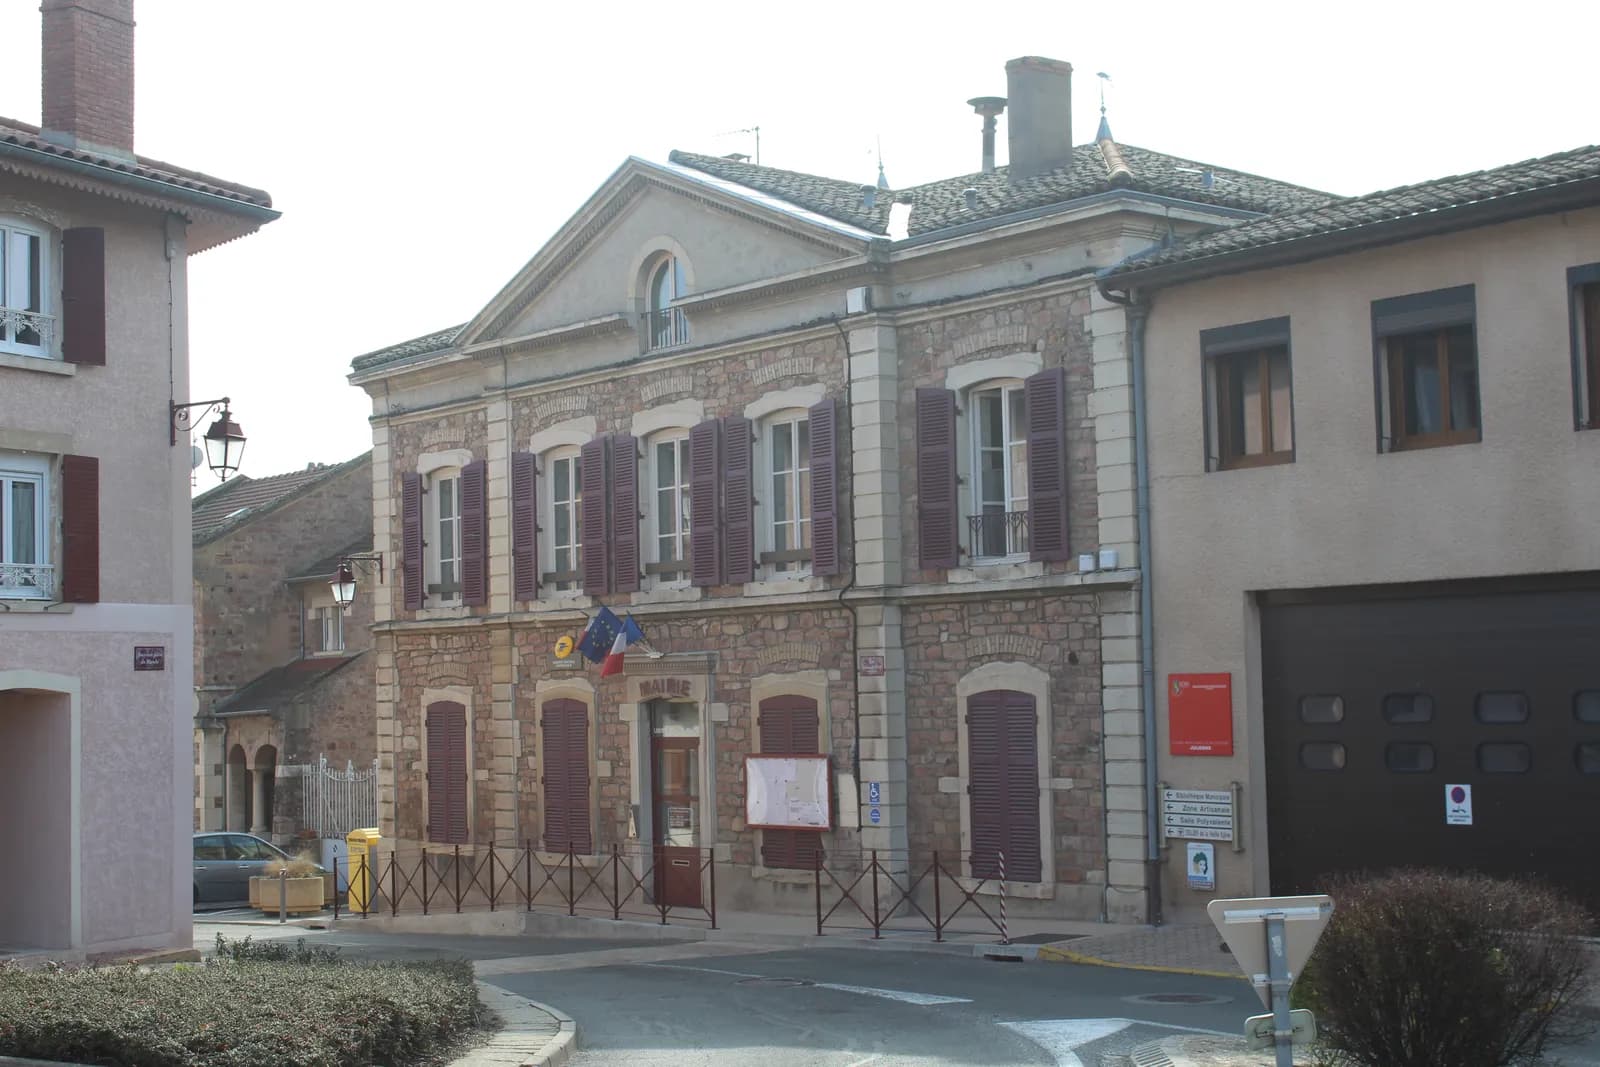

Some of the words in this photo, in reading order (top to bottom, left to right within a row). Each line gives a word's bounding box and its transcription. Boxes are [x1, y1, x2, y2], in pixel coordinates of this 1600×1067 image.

[639, 678, 691, 697] MAIRIE
[1200, 805, 1229, 813] Artisanale
[1180, 816, 1194, 824] Salle
[1196, 817, 1230, 825] Polyvalente
